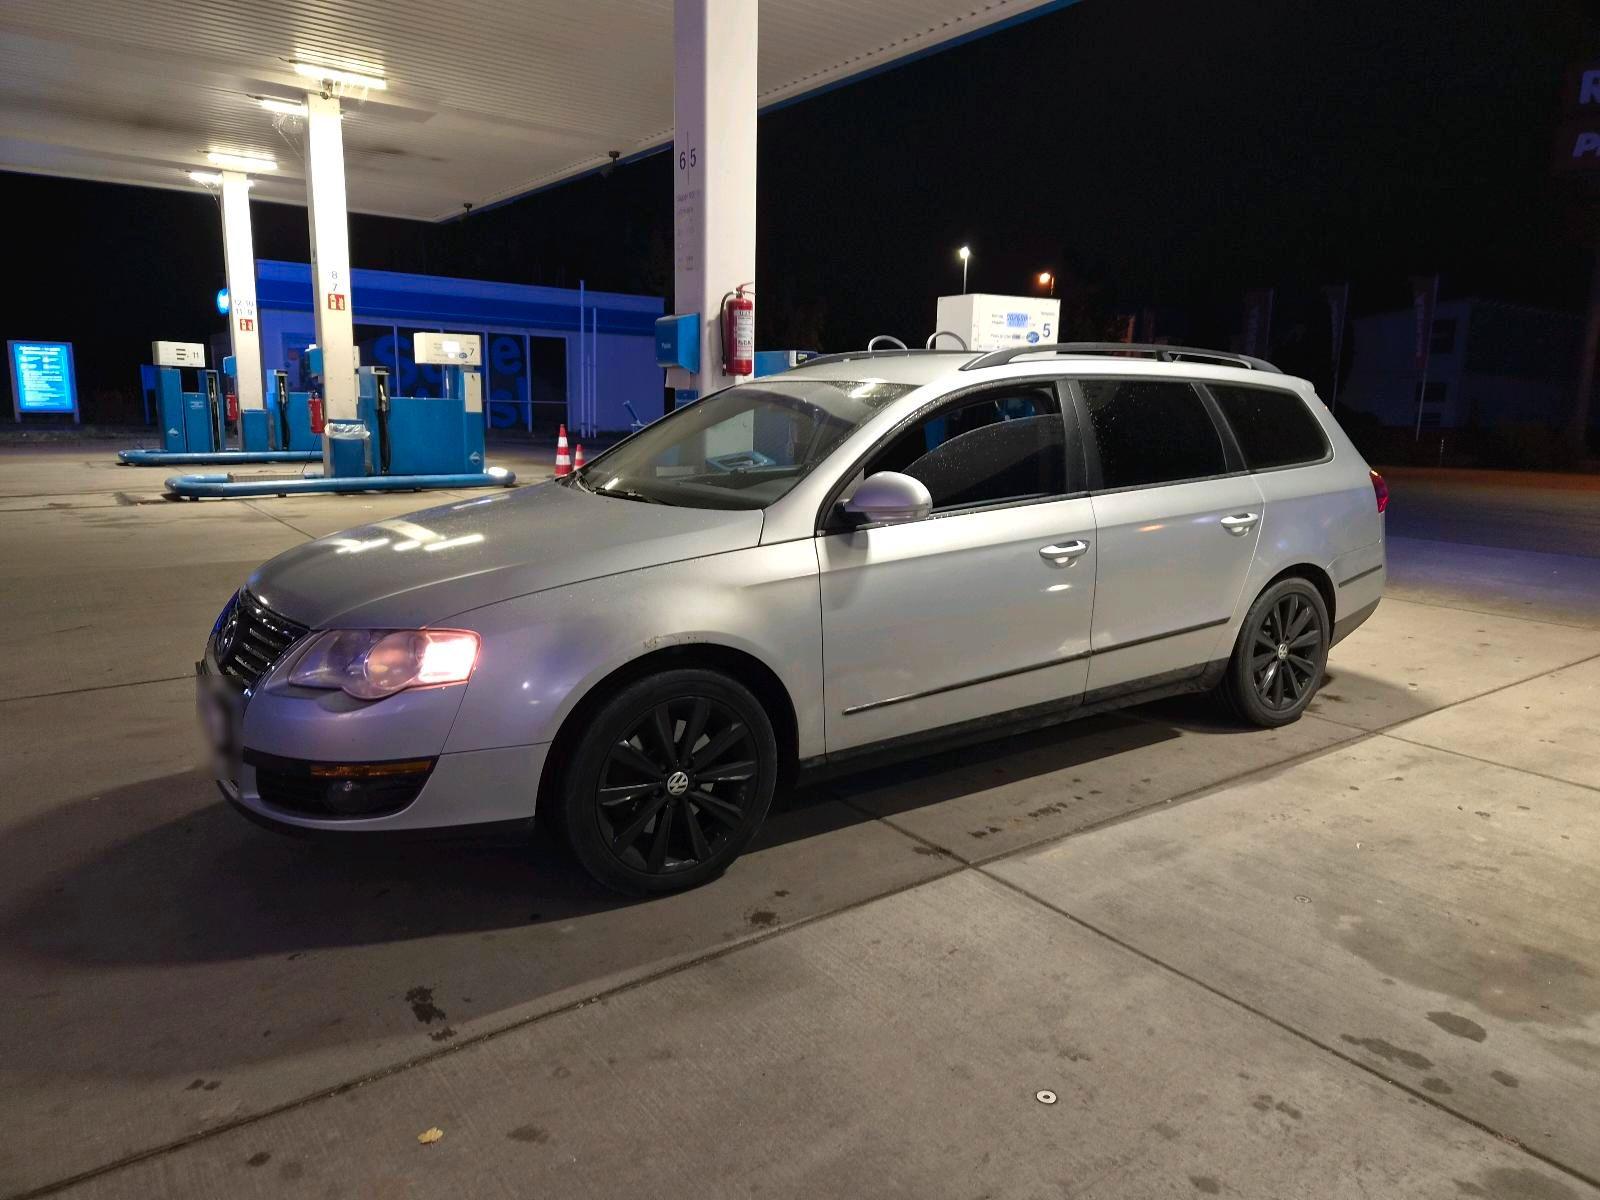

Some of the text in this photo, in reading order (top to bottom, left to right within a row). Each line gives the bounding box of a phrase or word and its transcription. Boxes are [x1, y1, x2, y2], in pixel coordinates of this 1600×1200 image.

[679, 147, 697, 170] 6 5
[331, 270, 338, 280] 8
[1042, 322, 1051, 338] 5
[193, 351, 200, 359] 11
[468, 347, 475, 357] 7
